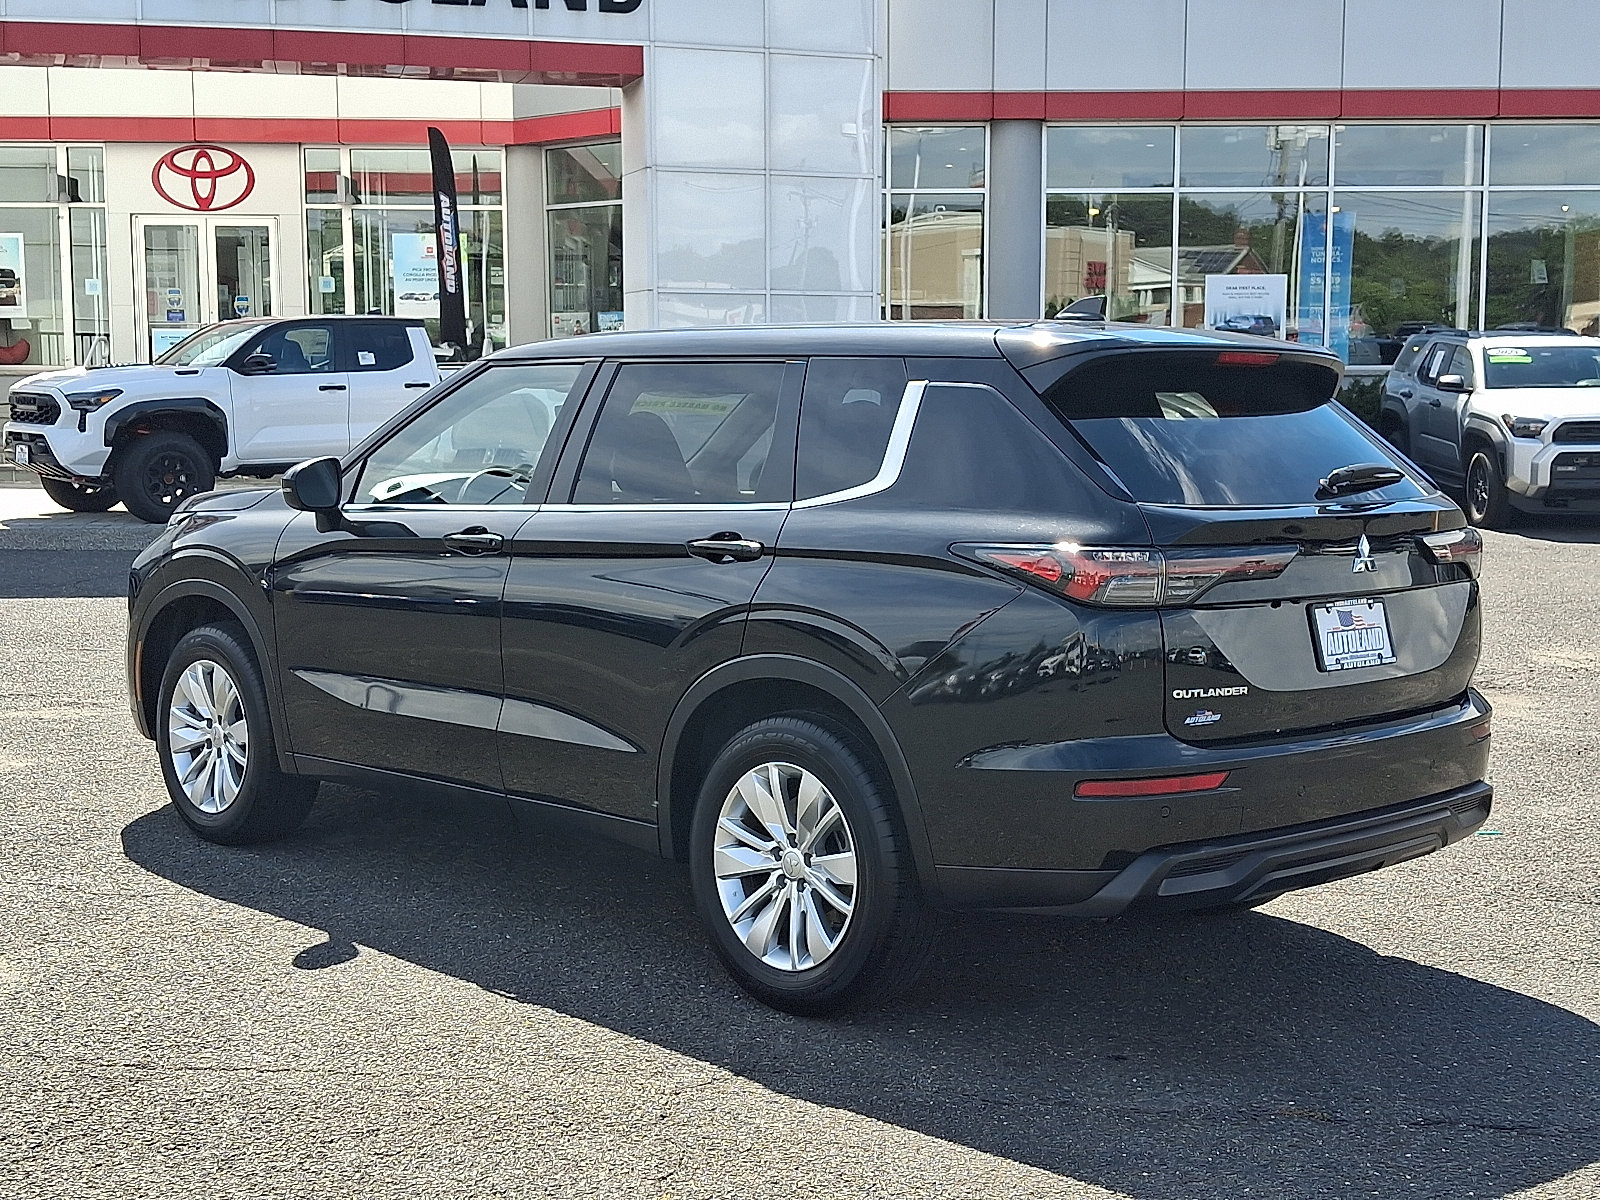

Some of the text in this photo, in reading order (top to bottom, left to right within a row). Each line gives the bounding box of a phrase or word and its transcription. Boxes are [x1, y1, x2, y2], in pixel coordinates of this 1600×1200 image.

[439, 191, 456, 294] AUTOLAND
[1327, 627, 1384, 656] AUTOLAND
[1343, 659, 1381, 669] AUTOLAND
[1172, 686, 1248, 699] OUTLANDER
[1184, 714, 1222, 724] AUTOLAND
